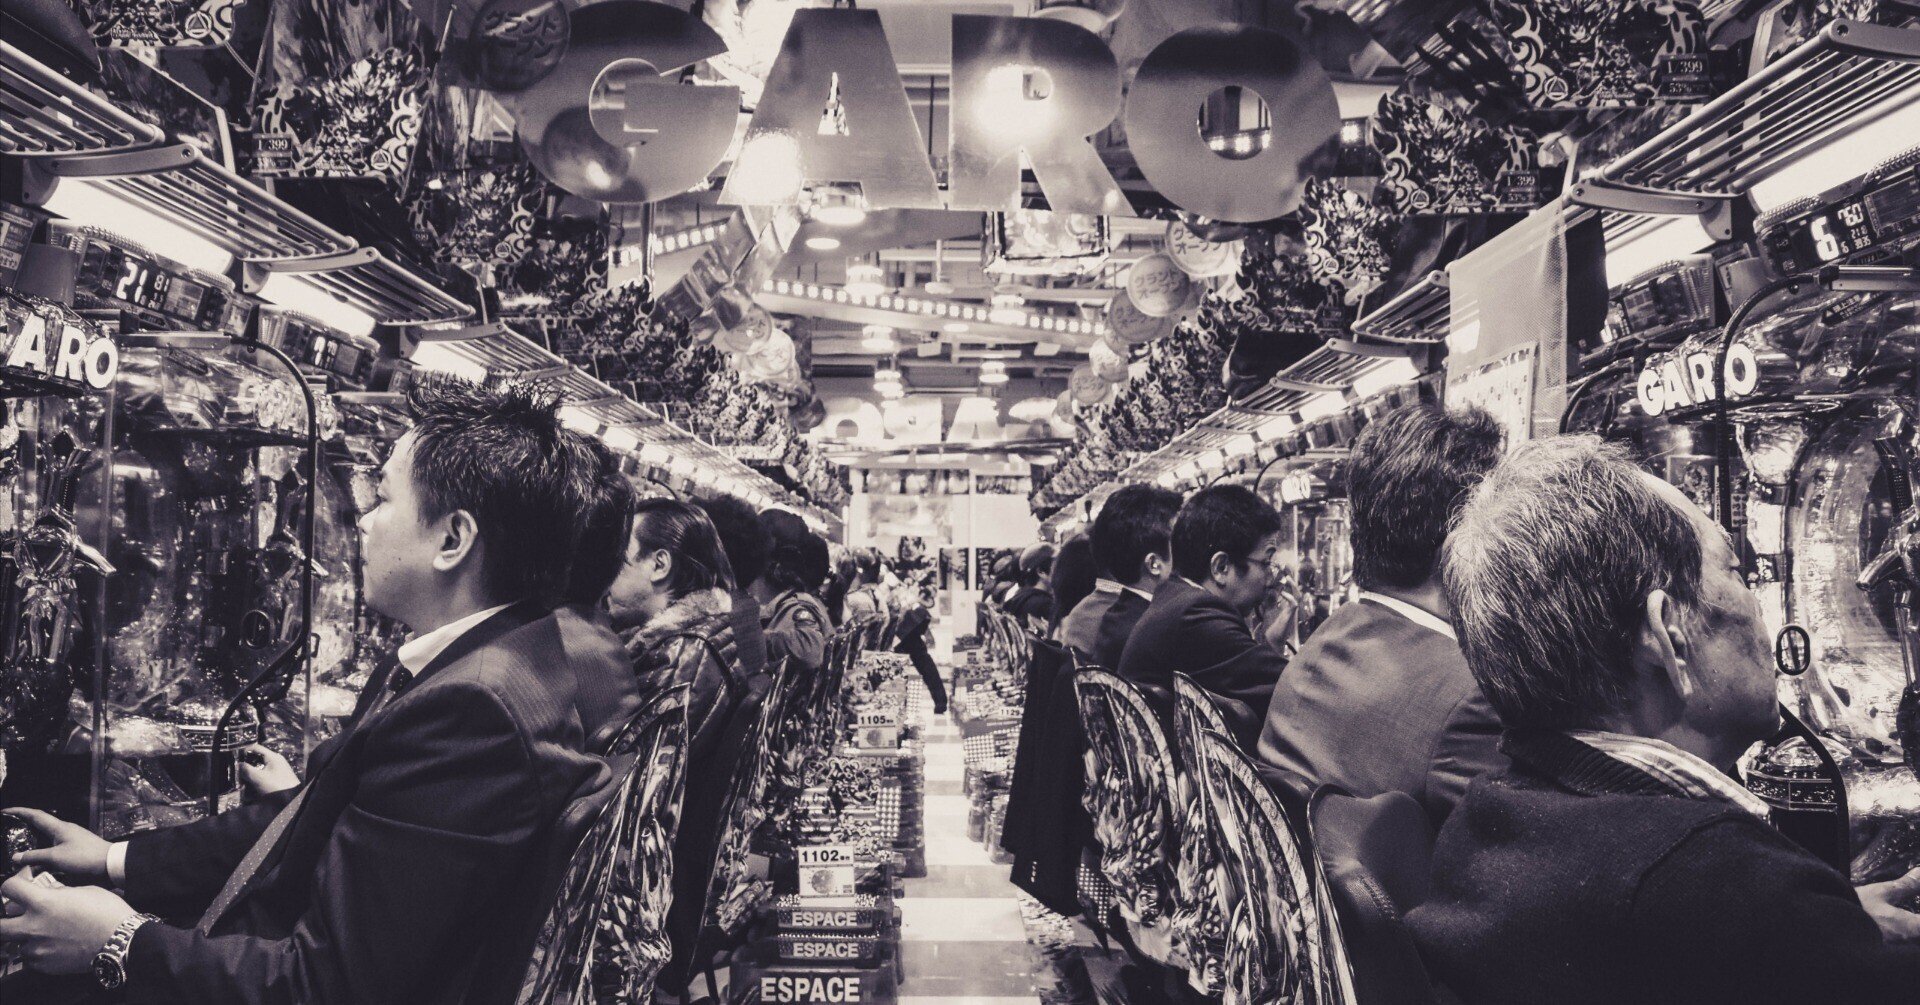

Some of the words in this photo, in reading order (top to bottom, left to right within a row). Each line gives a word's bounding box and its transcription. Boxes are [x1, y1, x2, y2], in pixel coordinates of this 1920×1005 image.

[514, 0, 1341, 223] GARO
[0, 310, 119, 389] ARO
[1637, 343, 1758, 417] GARO
[855, 756, 899, 768] SPACE
[802, 850, 839, 862] 1102
[791, 911, 858, 927] ESPACE
[793, 942, 859, 958] ESPACE
[761, 977, 860, 1003] ESPACE
